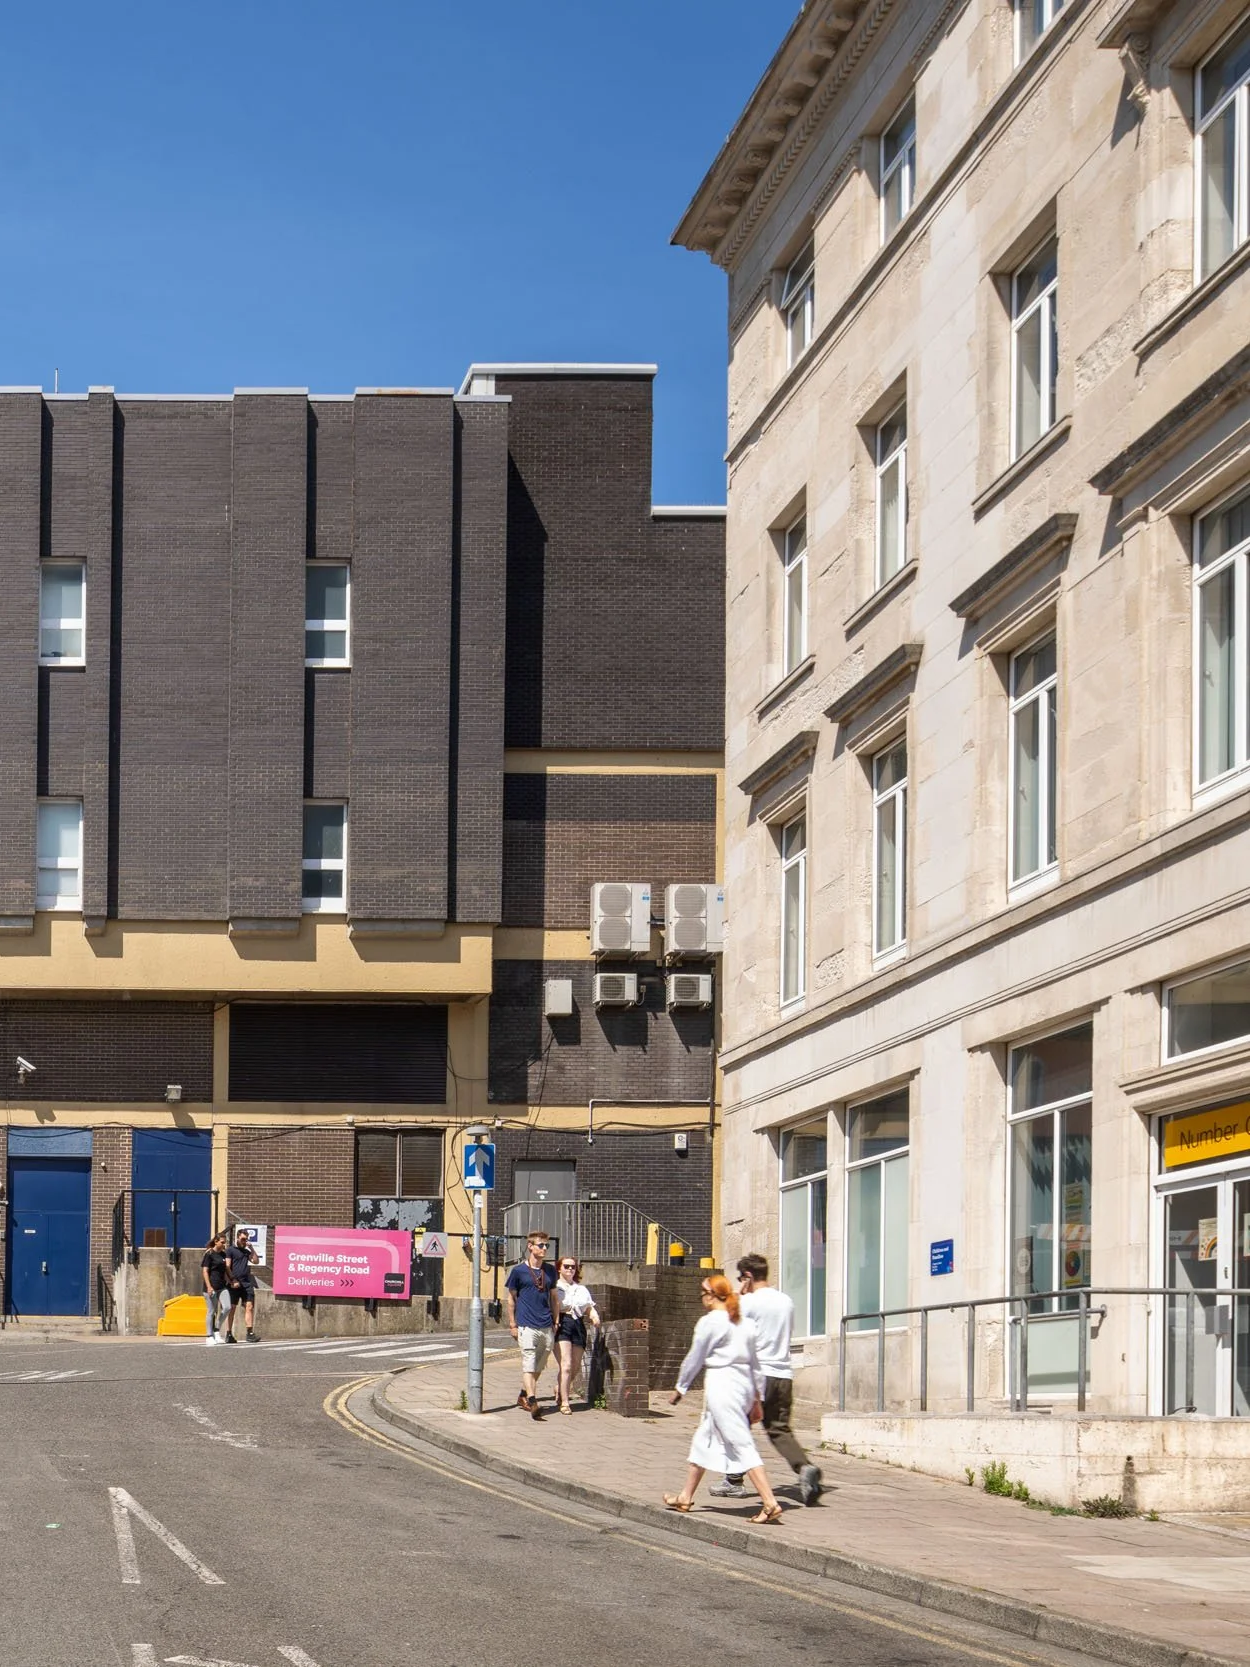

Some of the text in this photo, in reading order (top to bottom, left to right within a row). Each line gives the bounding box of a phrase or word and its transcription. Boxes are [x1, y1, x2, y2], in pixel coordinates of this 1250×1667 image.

[1179, 1121, 1238, 1151] Number
[288, 1253, 368, 1264] Grenville Street
[288, 1263, 370, 1275] & Regency Road
[288, 1277, 335, 1287] Deliveries
